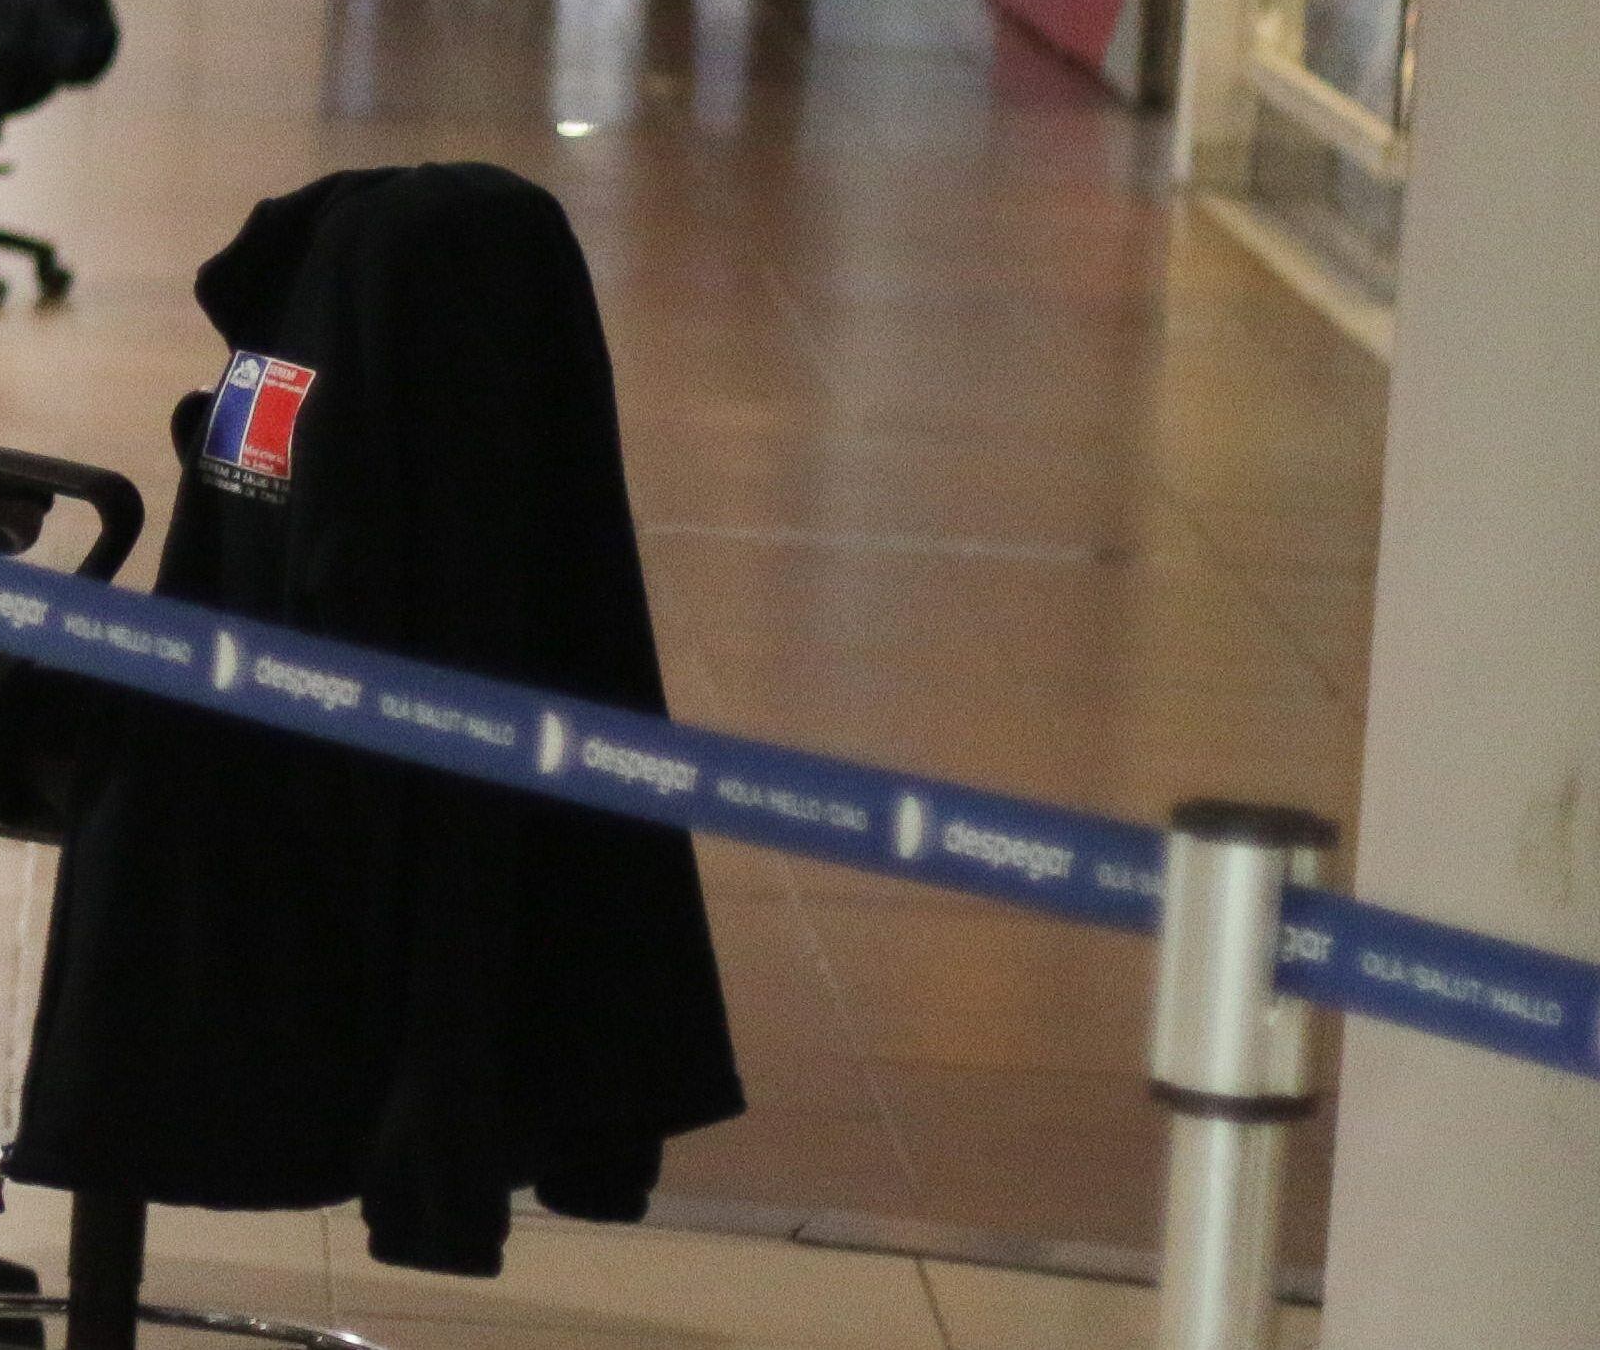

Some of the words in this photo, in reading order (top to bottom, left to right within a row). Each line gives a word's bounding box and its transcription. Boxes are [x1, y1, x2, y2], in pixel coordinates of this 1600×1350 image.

[256, 656, 363, 711] despegar
[583, 737, 699, 795] despegar
[944, 821, 1075, 881] despegar
[1360, 949, 1405, 983] OLA
[1407, 962, 1484, 1003] SALUT
[1487, 985, 1564, 1027] HALLO
